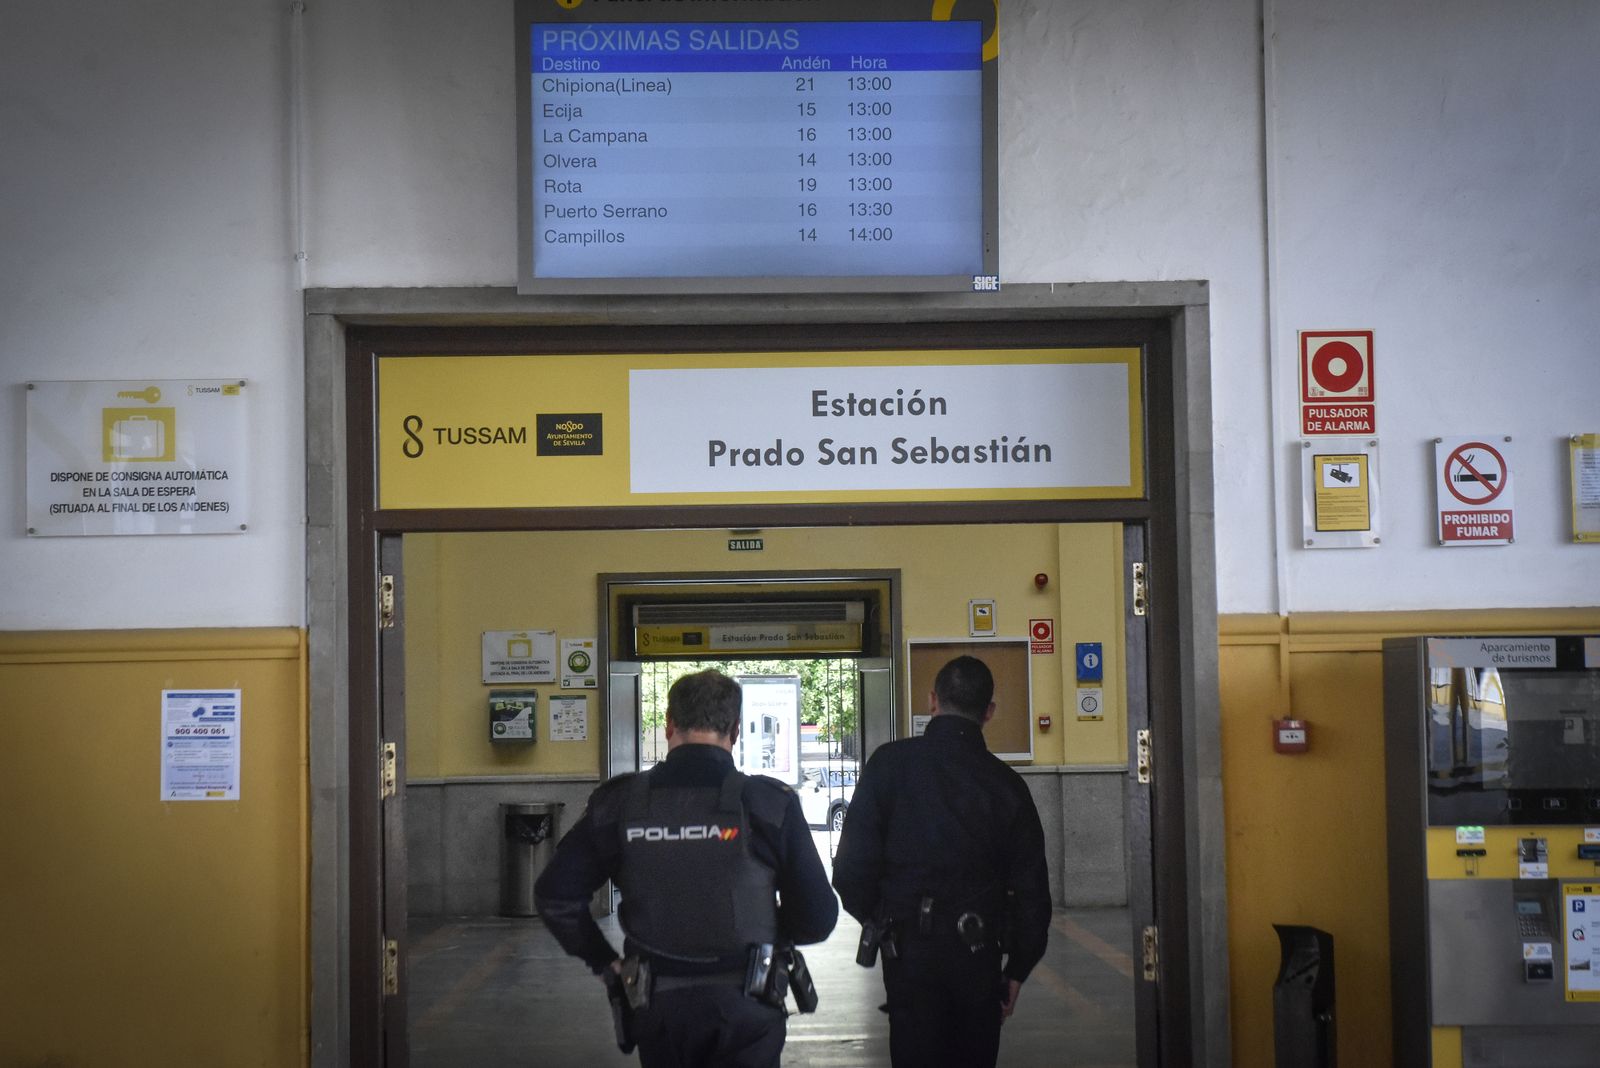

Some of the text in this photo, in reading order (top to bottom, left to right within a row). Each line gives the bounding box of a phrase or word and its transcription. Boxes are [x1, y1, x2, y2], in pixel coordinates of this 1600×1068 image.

[543, 25, 799, 51] PRÓXIMAS SALIDAS
[542, 56, 888, 72] Destino Andén Hora
[543, 77, 891, 97] Chipiona(Linea) 21 13:00
[543, 102, 891, 121] Ecija 15 13:00
[544, 127, 891, 147] La Campana 16 13:00
[544, 153, 891, 168] Olvera 14 13:00
[544, 178, 892, 193] Rota 19 13:00
[544, 202, 892, 218] Puerto Serrano 16 13:30
[544, 227, 892, 247] Campillos 14 14:00
[974, 276, 998, 290] SICE
[812, 389, 947, 417] Estación
[1308, 408, 1368, 419] PULSADOR
[1307, 421, 1370, 431] DE ALARMA
[432, 427, 527, 445] TUSSAM
[709, 435, 1052, 467] Prado San Sebastián
[50, 468, 228, 482] DISPONE DE CONSIGNA AUTOMÁTICA
[83, 487, 196, 497] EN LA SALA DE ESPERA
[50, 501, 229, 515] (SITUADA AL FINAL DE LOS ANDENES)
[1445, 514, 1510, 525] PROHIBIDO
[1456, 526, 1499, 537] FUMAR
[730, 541, 761, 549] SALIDA
[721, 631, 845, 643] Estación Prado San Sebastián
[1481, 642, 1551, 655] Aparcamiento
[1492, 652, 1551, 664] de turismos
[627, 824, 721, 842] POLICIA
